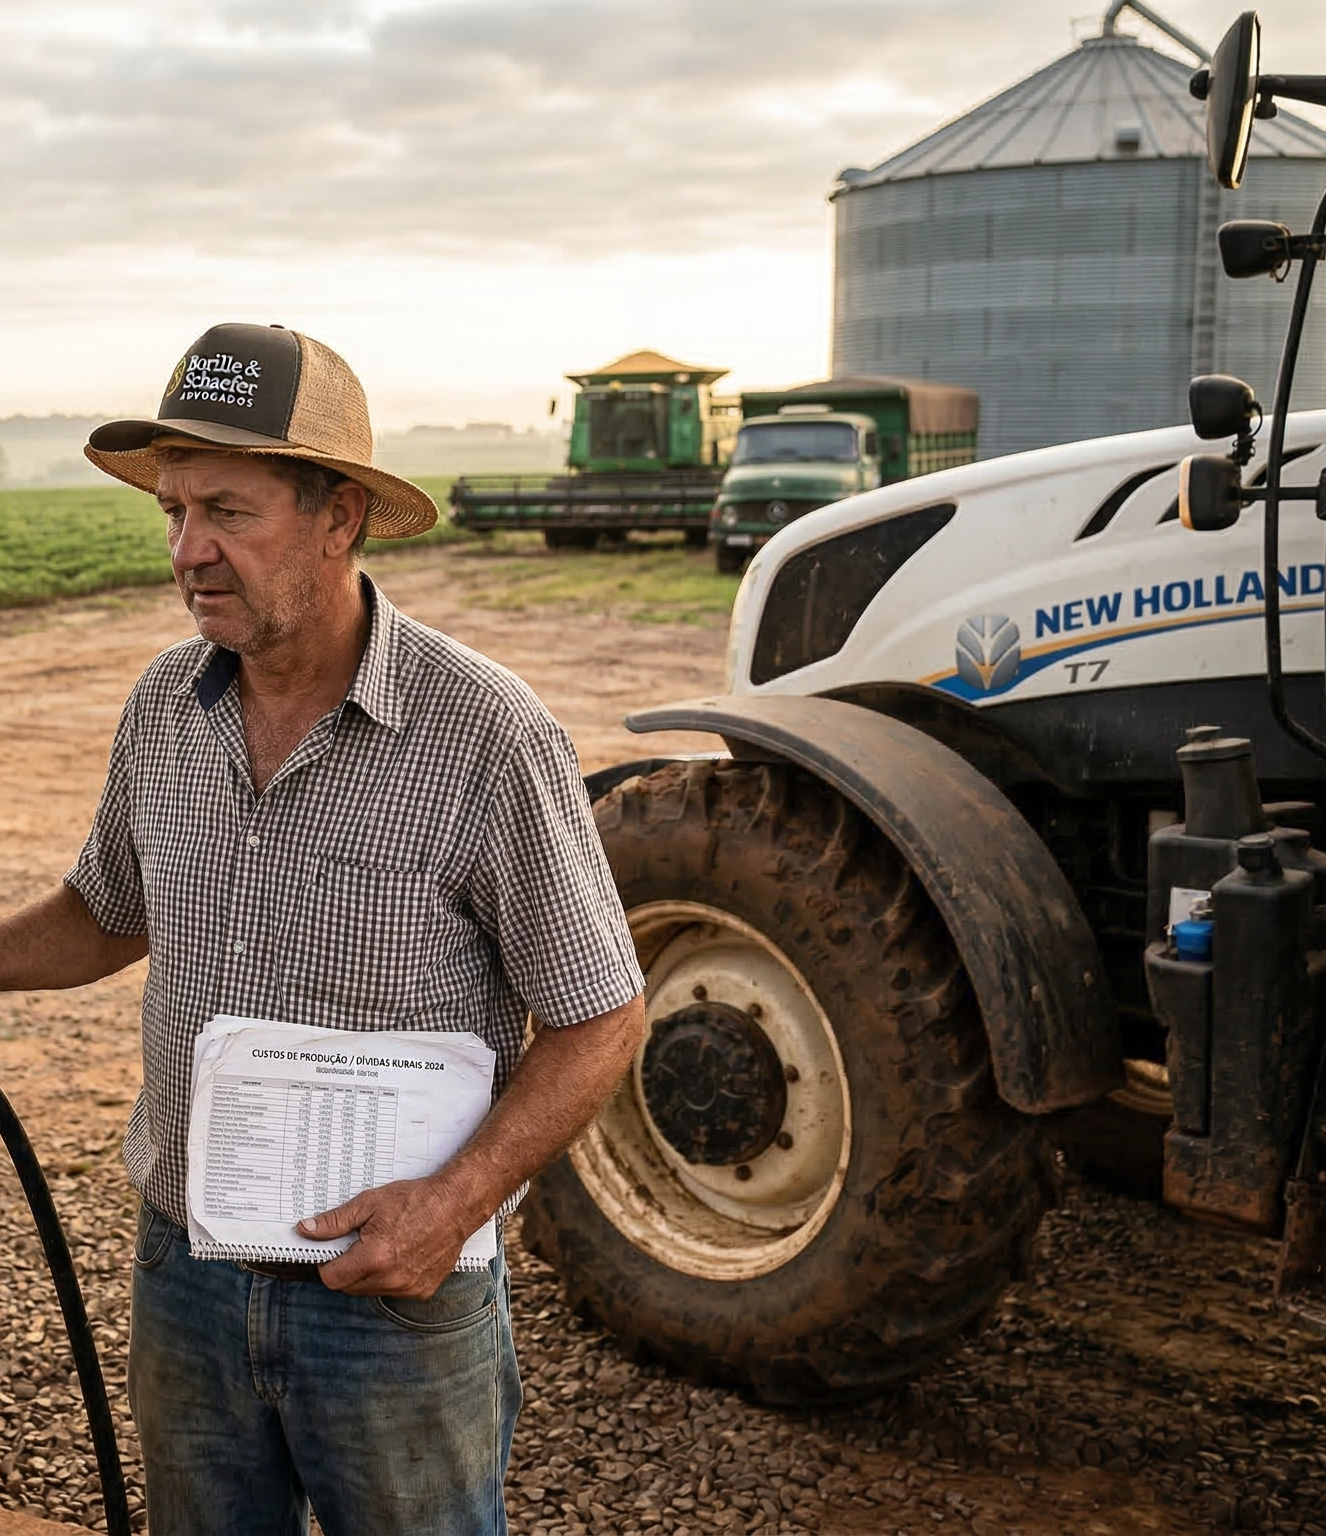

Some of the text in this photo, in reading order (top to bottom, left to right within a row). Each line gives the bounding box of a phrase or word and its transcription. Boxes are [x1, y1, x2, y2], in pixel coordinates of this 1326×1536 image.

[186, 353, 262, 378] Borille &
[182, 371, 258, 397] Schaefer
[179, 391, 254, 408] ADVOGADOS
[1036, 592, 1122, 639] NEW
[1064, 659, 1110, 684] T7
[252, 1048, 285, 1060] CUSTOS
[287, 1051, 299, 1061] DE
[300, 1052, 348, 1065] PRODUÇÃO
[349, 1055, 355, 1067] /
[424, 1061, 445, 1071] 2024
